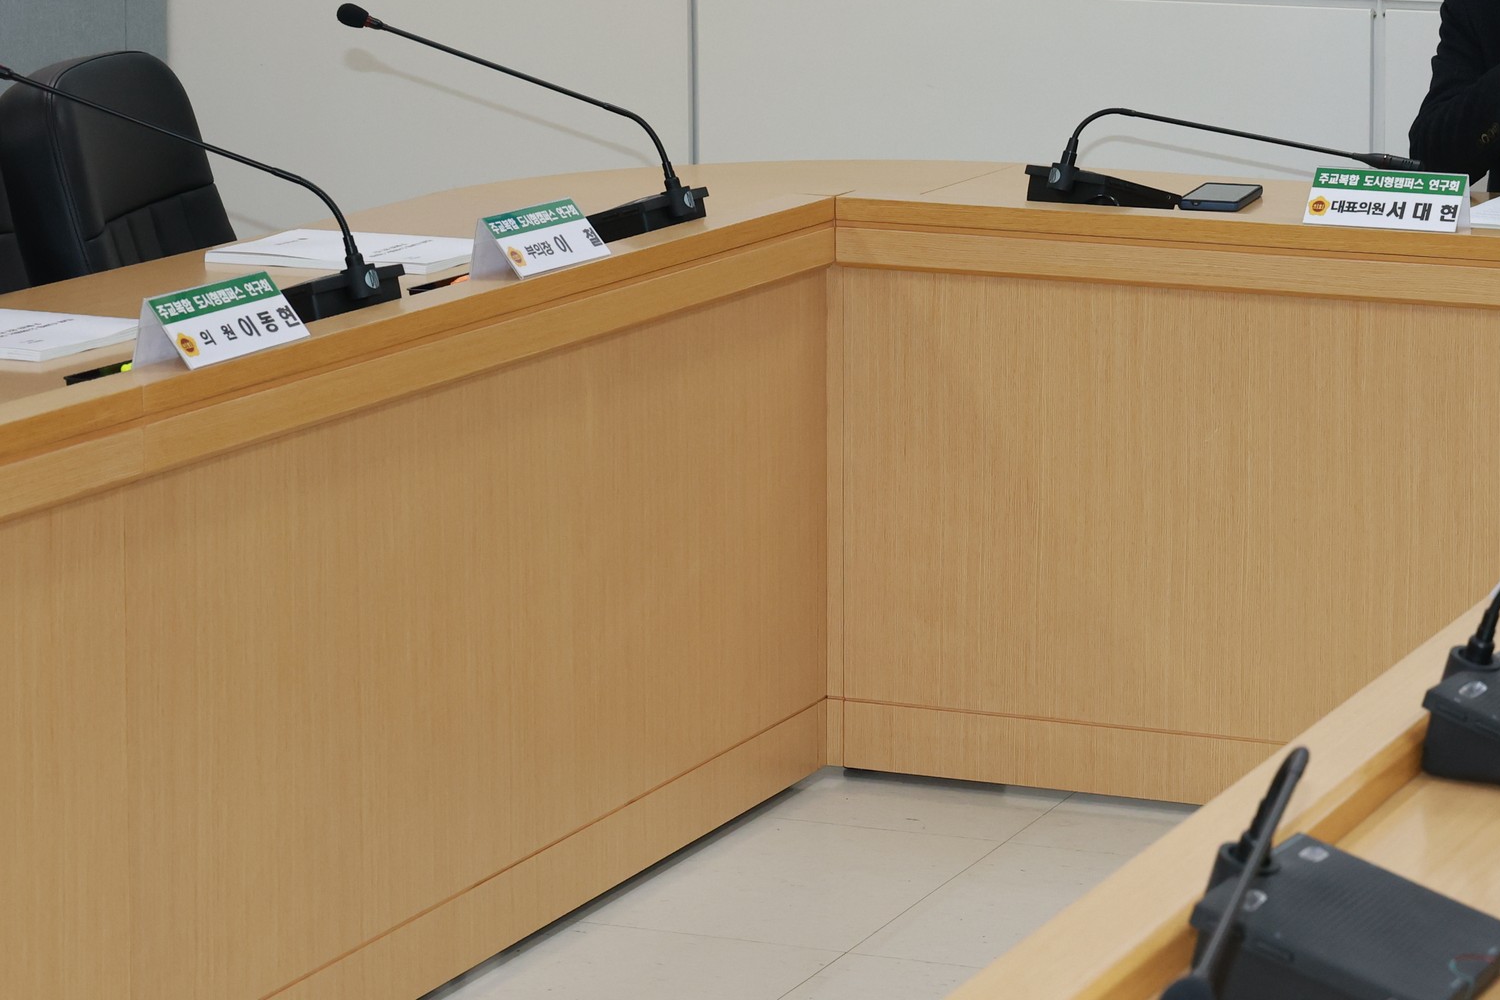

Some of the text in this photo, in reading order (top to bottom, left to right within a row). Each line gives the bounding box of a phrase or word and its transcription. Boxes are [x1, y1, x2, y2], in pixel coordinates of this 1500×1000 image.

[1319, 173, 1460, 192] 주교복합 도시형캠퍼스 연구회
[1331, 200, 1386, 216] 대표의원
[488, 204, 580, 234] 주교복합 도시형캠퍼스 연구회
[524, 240, 554, 259] 부의장
[155, 279, 274, 319] 주교복합 도시형캠퍼스 연구회
